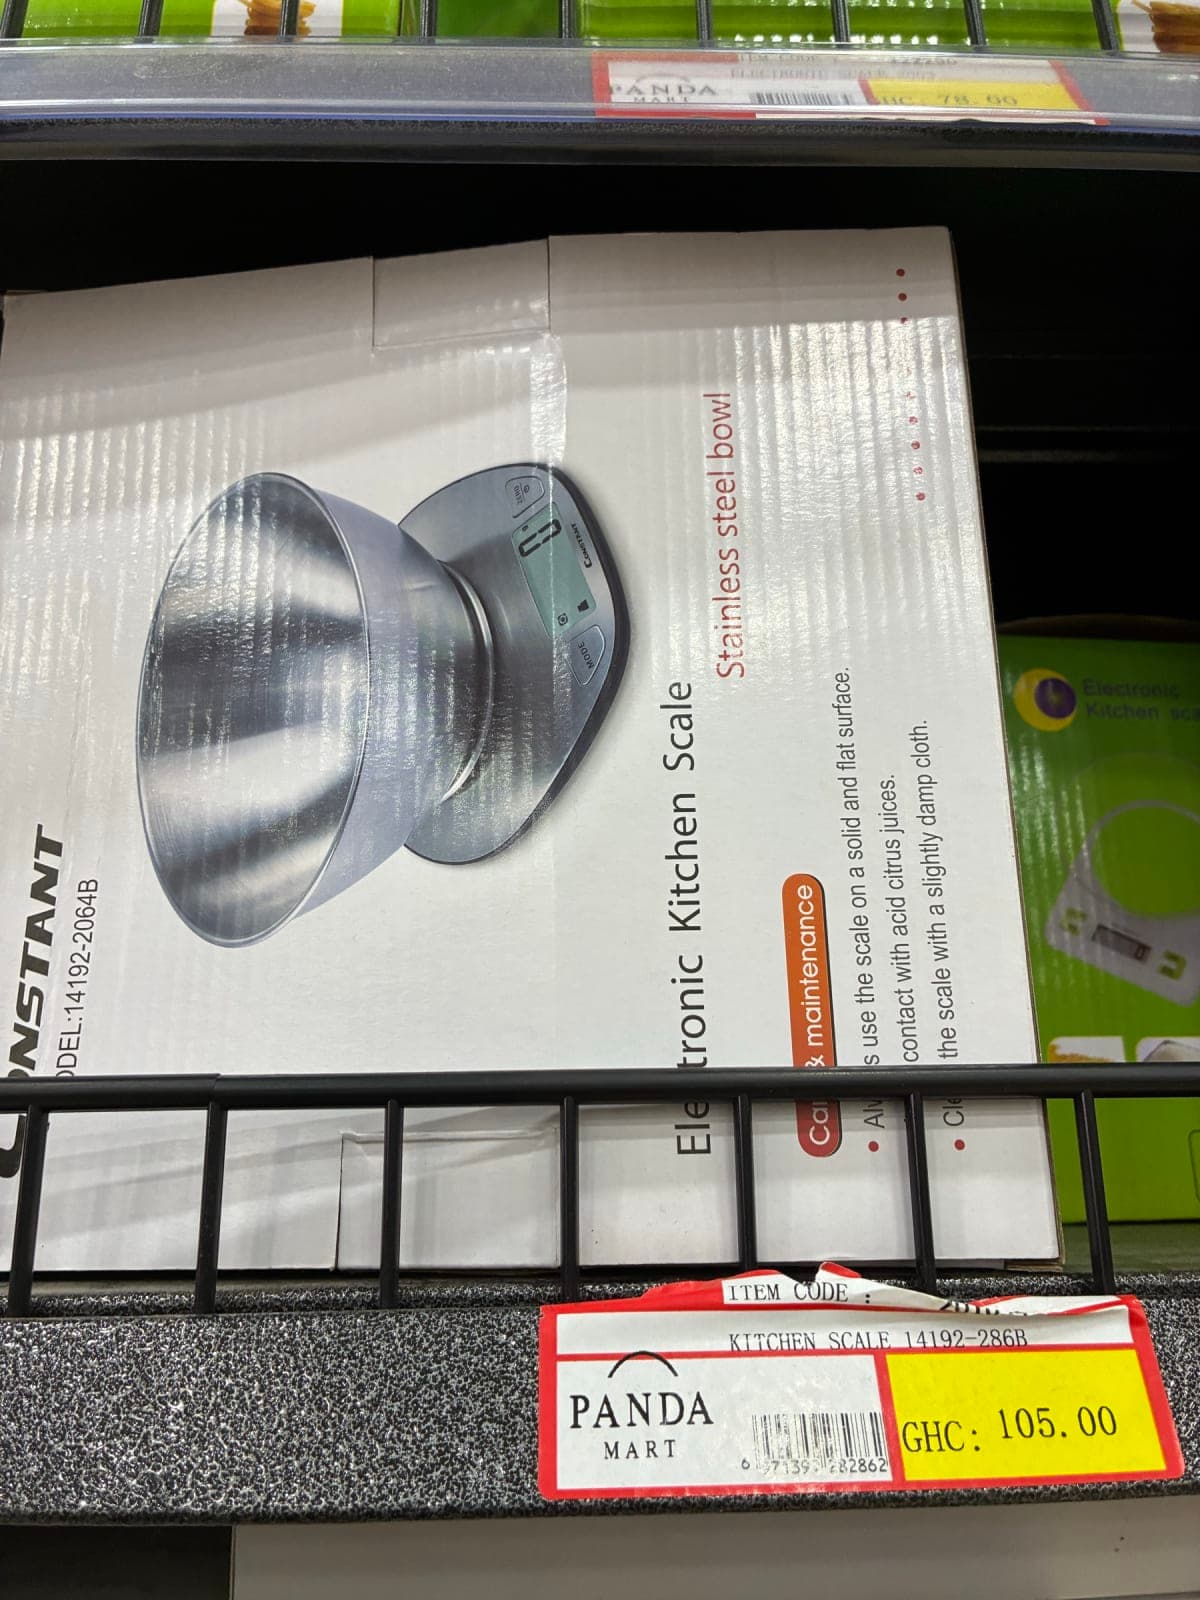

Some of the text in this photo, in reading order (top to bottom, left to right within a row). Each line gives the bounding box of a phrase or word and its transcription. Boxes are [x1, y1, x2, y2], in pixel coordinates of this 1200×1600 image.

[703, 393, 745, 678] Stainless steel bowl
[577, 641, 595, 669] MODE
[832, 666, 854, 738] surface.
[1082, 677, 1181, 698] Electronic
[1086, 703, 1161, 720] Kitchen
[836, 743, 857, 772] flat
[908, 720, 932, 769] cloth.
[837, 776, 860, 811] and
[915, 774, 938, 827] damp
[840, 817, 864, 860] solid
[849, 866, 866, 878] a
[918, 831, 947, 898] slightly
[850, 884, 868, 909] on
[929, 903, 945, 916] a
[660, 681, 712, 1155] Eletronic Kitchen Scale
[878, 774, 920, 1063] contact with acid citrus juices.
[848, 914, 872, 967] scale
[926, 921, 949, 962] with
[797, 884, 824, 1047] maintenance
[853, 972, 874, 1004] the
[930, 967, 955, 1020] scale
[860, 1010, 879, 1048] use
[937, 1027, 959, 1060] the
[728, 1282, 780, 1302] ITEM
[793, 1282, 849, 1303] CODE
[728, 1328, 1029, 1353] KITCHEN SCALE 14192-286B
[569, 1391, 715, 1429] PANDA
[902, 1405, 1118, 1453] GHC: 105.00
[604, 1439, 677, 1460] MART
